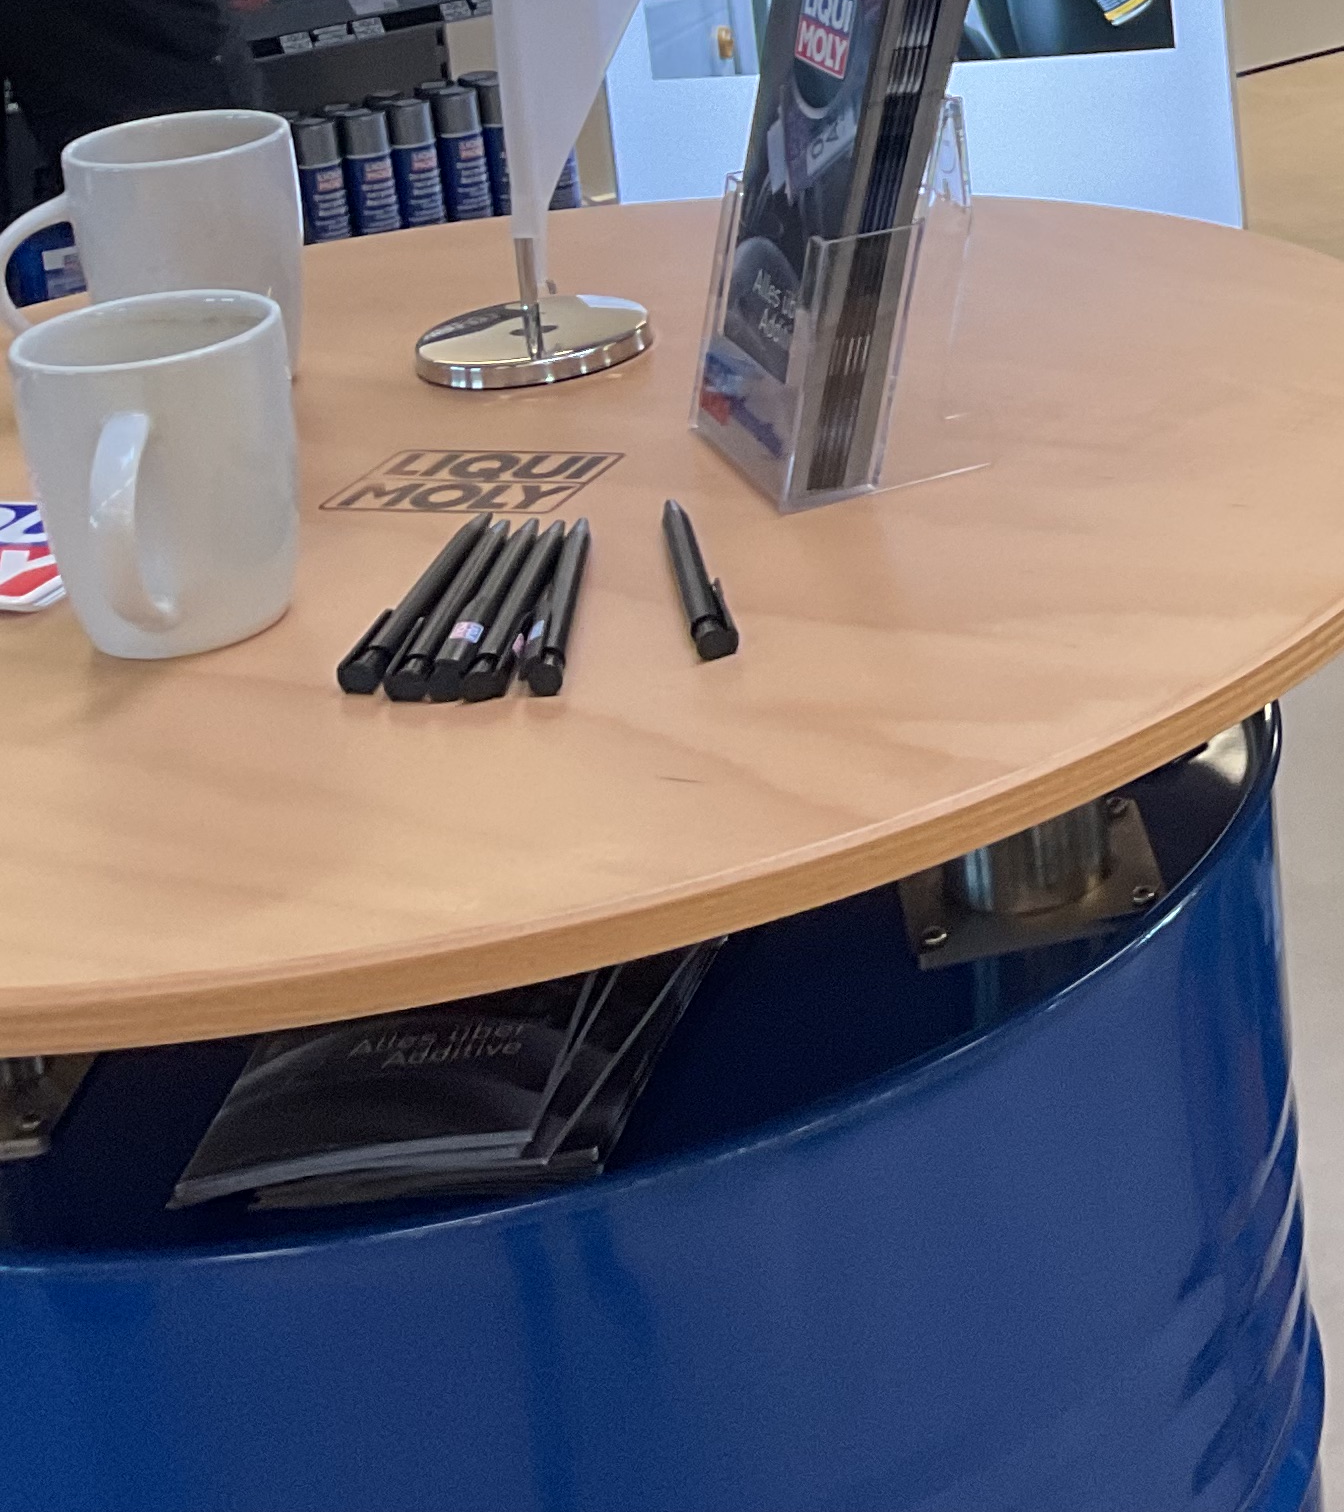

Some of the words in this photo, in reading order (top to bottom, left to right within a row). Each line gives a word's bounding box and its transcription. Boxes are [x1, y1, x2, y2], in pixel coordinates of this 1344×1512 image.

[798, 20, 849, 72] MOLY
[382, 452, 608, 481] LIQUI
[338, 482, 571, 510] MOLY
[382, 1041, 522, 1069] Additive
